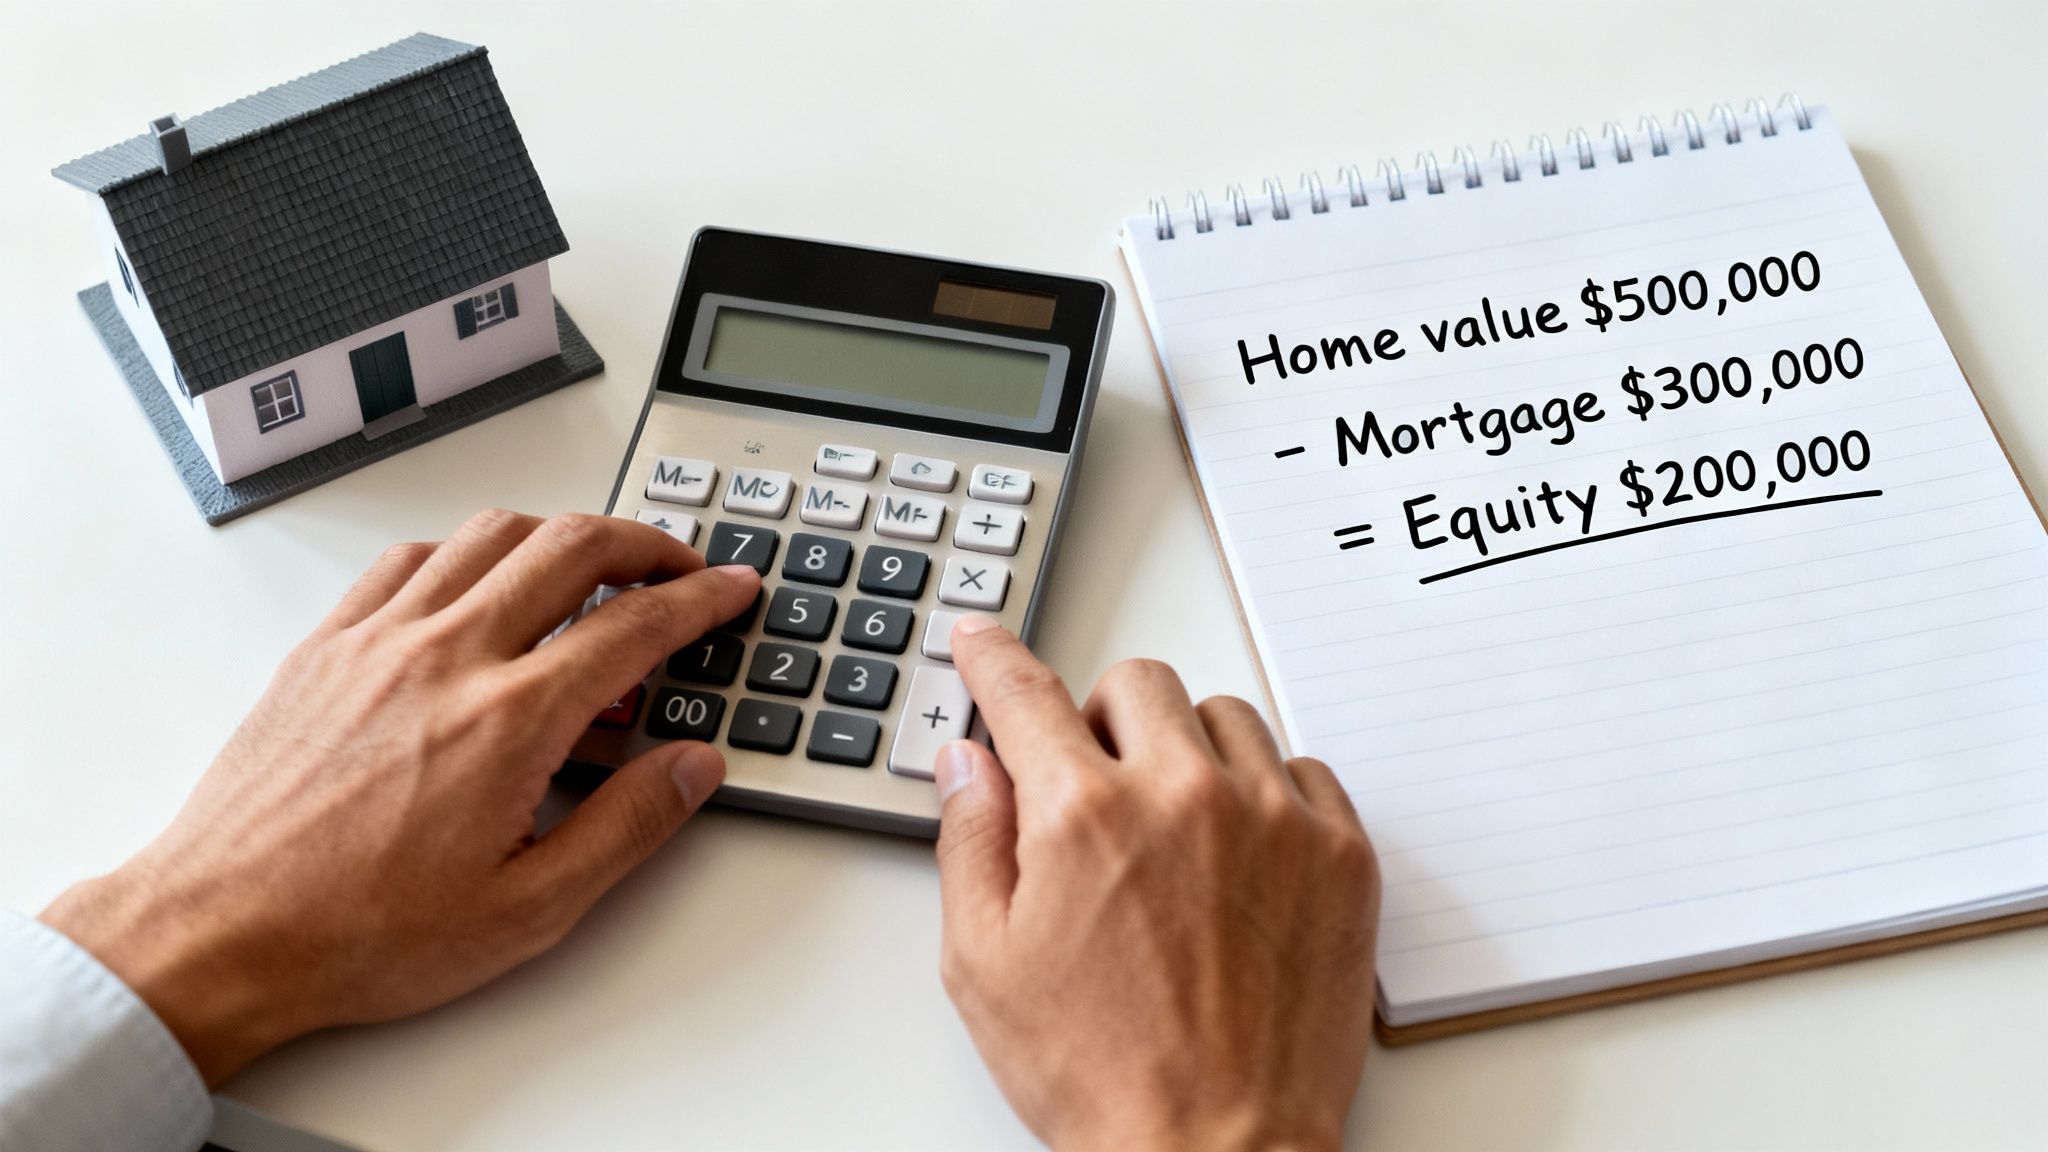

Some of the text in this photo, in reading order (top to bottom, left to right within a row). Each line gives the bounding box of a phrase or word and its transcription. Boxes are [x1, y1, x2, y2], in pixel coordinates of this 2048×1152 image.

[1237, 250, 1821, 386] Home value $500,000
[1335, 392, 1606, 467] Mortgage
[1620, 337, 1864, 422] $300,000
[1333, 429, 1871, 557] = Equity $200,000
[731, 533, 754, 561] 7
[804, 544, 828, 570] 8
[881, 555, 903, 582] 9
[788, 598, 810, 624] 5
[864, 610, 887, 636] 6
[702, 645, 713, 667] 1
[769, 652, 794, 681] 2
[847, 666, 869, 692] 3
[665, 696, 708, 726] 00
